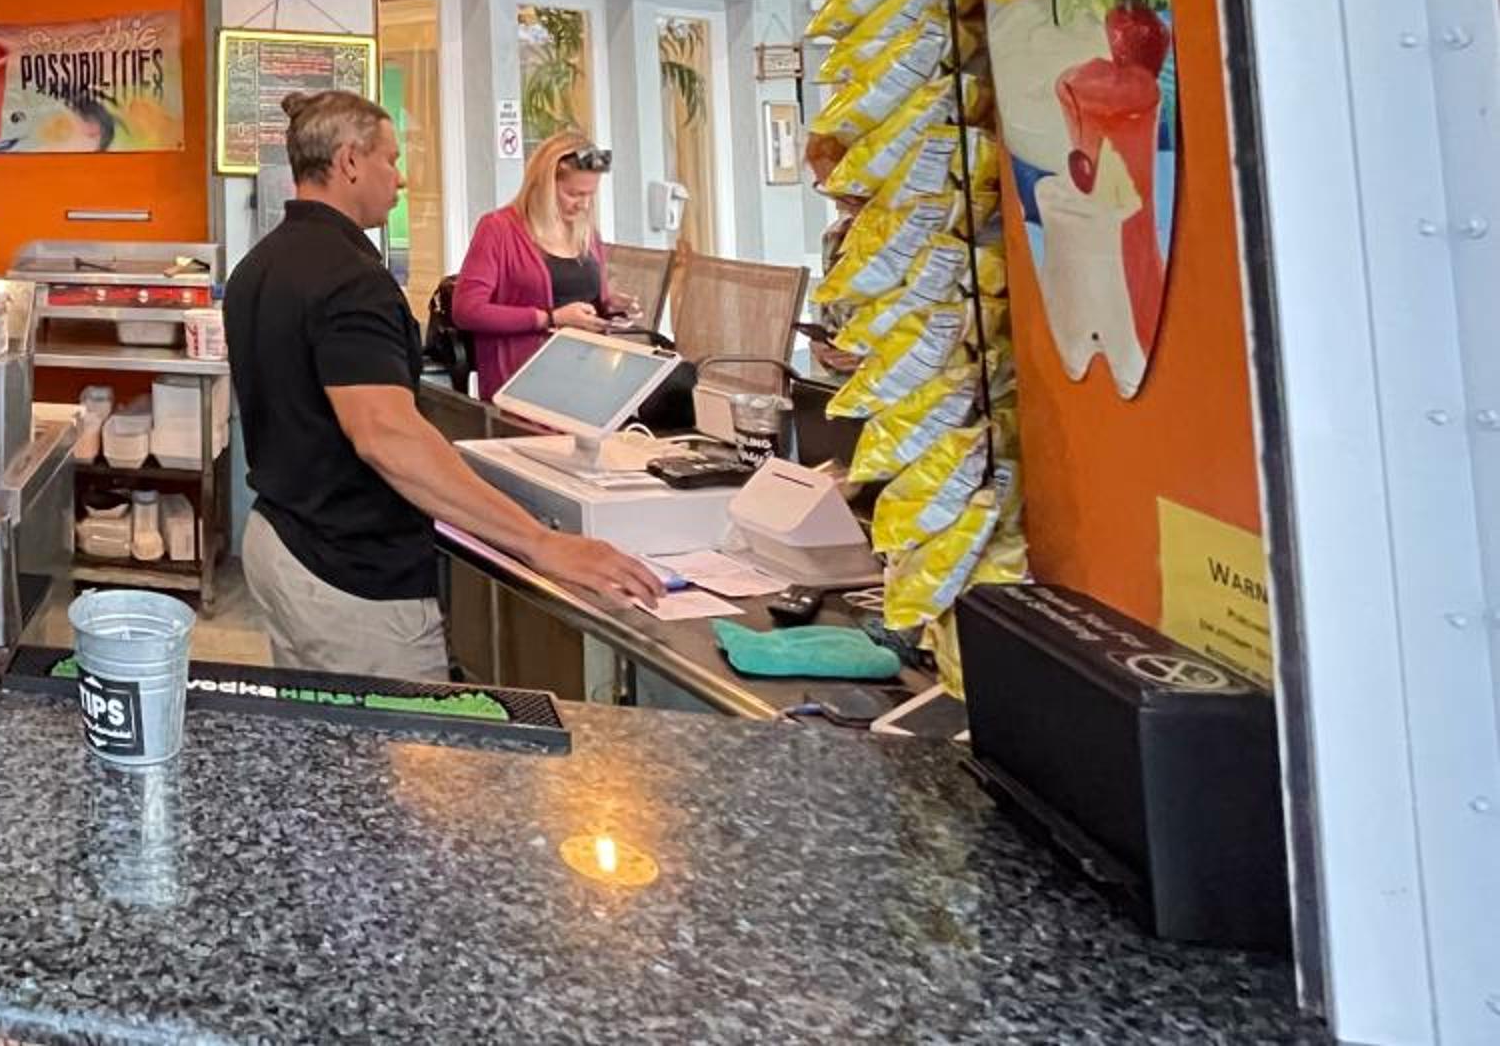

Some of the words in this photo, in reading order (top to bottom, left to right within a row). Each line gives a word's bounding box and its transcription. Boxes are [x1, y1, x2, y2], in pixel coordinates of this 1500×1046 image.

[27, 18, 161, 53] Smoothie
[21, 49, 164, 93] POSSIBILITIES
[1207, 556, 1269, 604] WARN
[78, 682, 126, 727] TIPS
[186, 679, 277, 699] vodka
